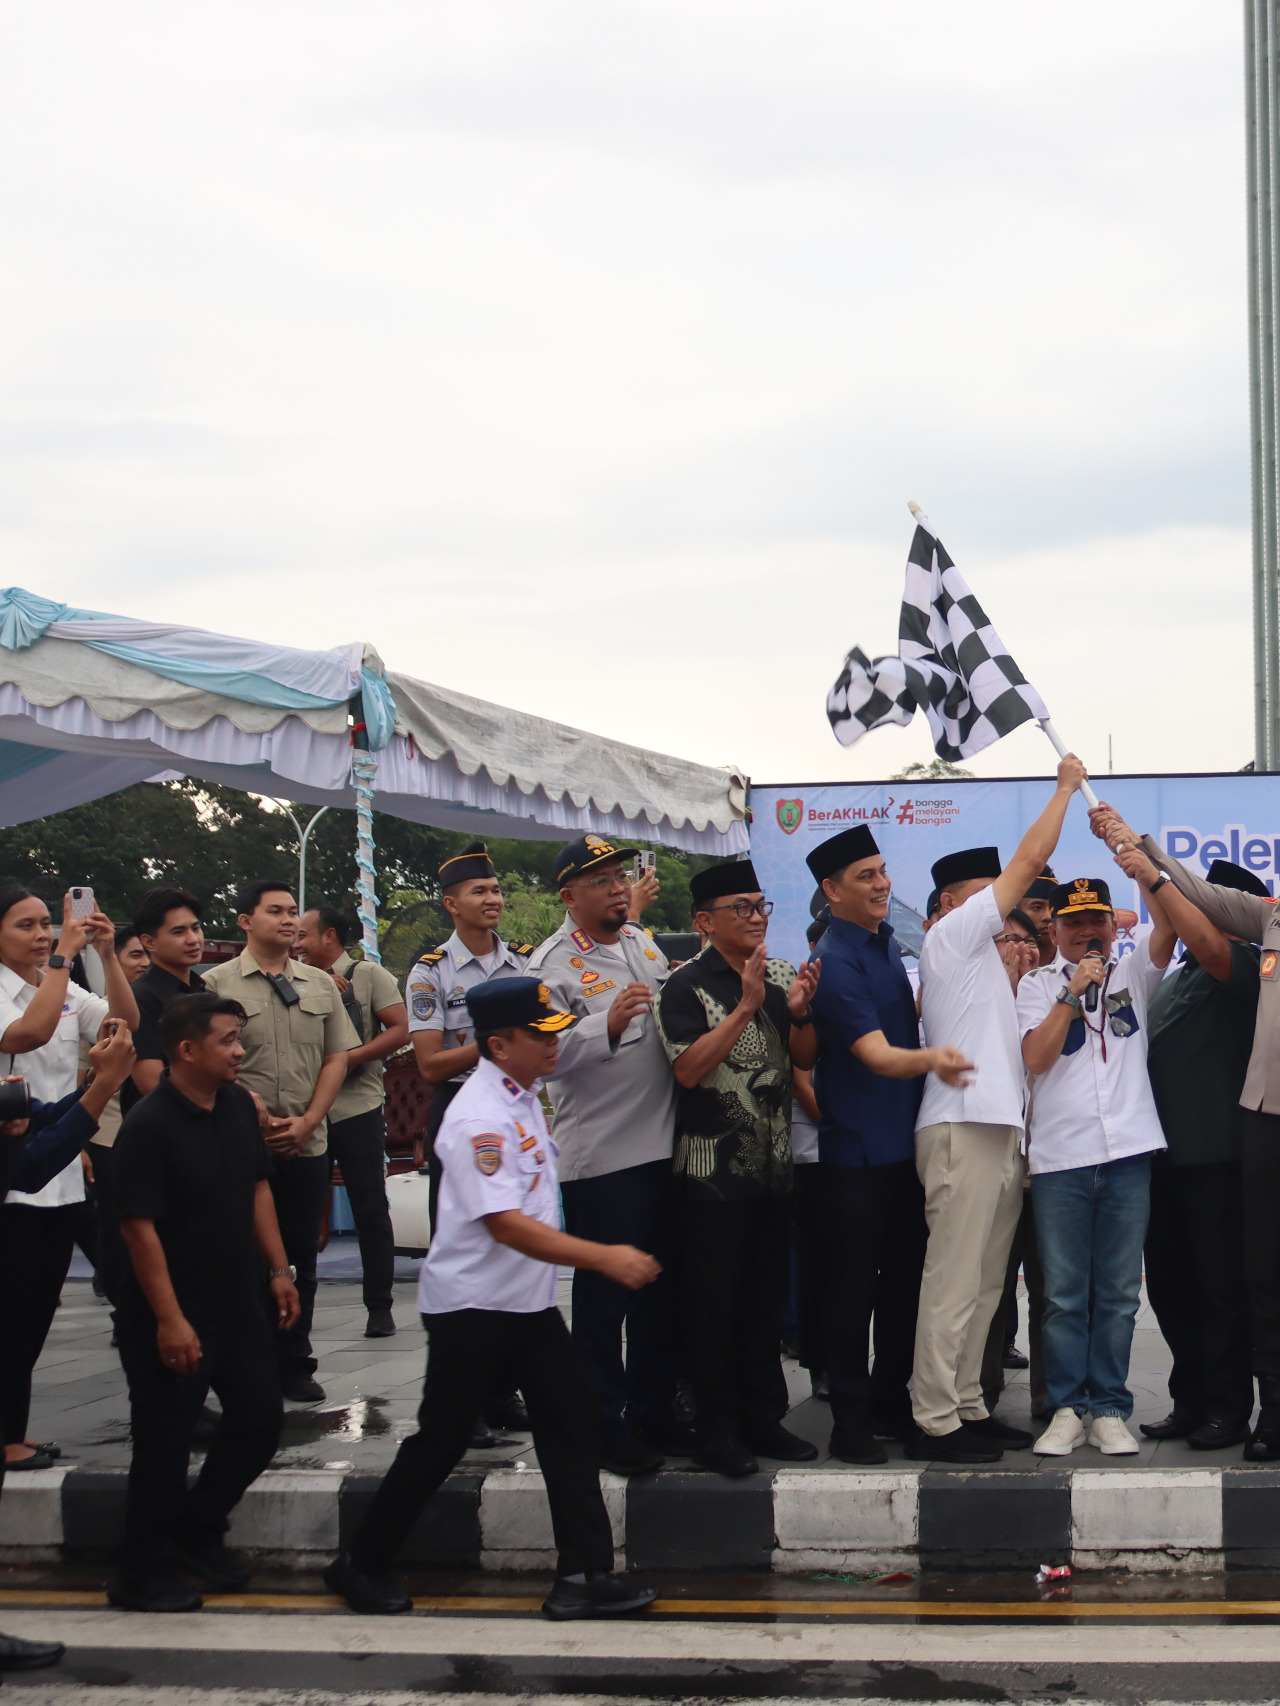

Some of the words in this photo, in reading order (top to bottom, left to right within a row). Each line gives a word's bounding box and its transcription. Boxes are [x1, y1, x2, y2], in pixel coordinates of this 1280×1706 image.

[915, 799, 953, 808] bangga
[808, 807, 890, 821] BerAKHLAK
[915, 806, 960, 815] melayani
[915, 817, 951, 826] bangsa
